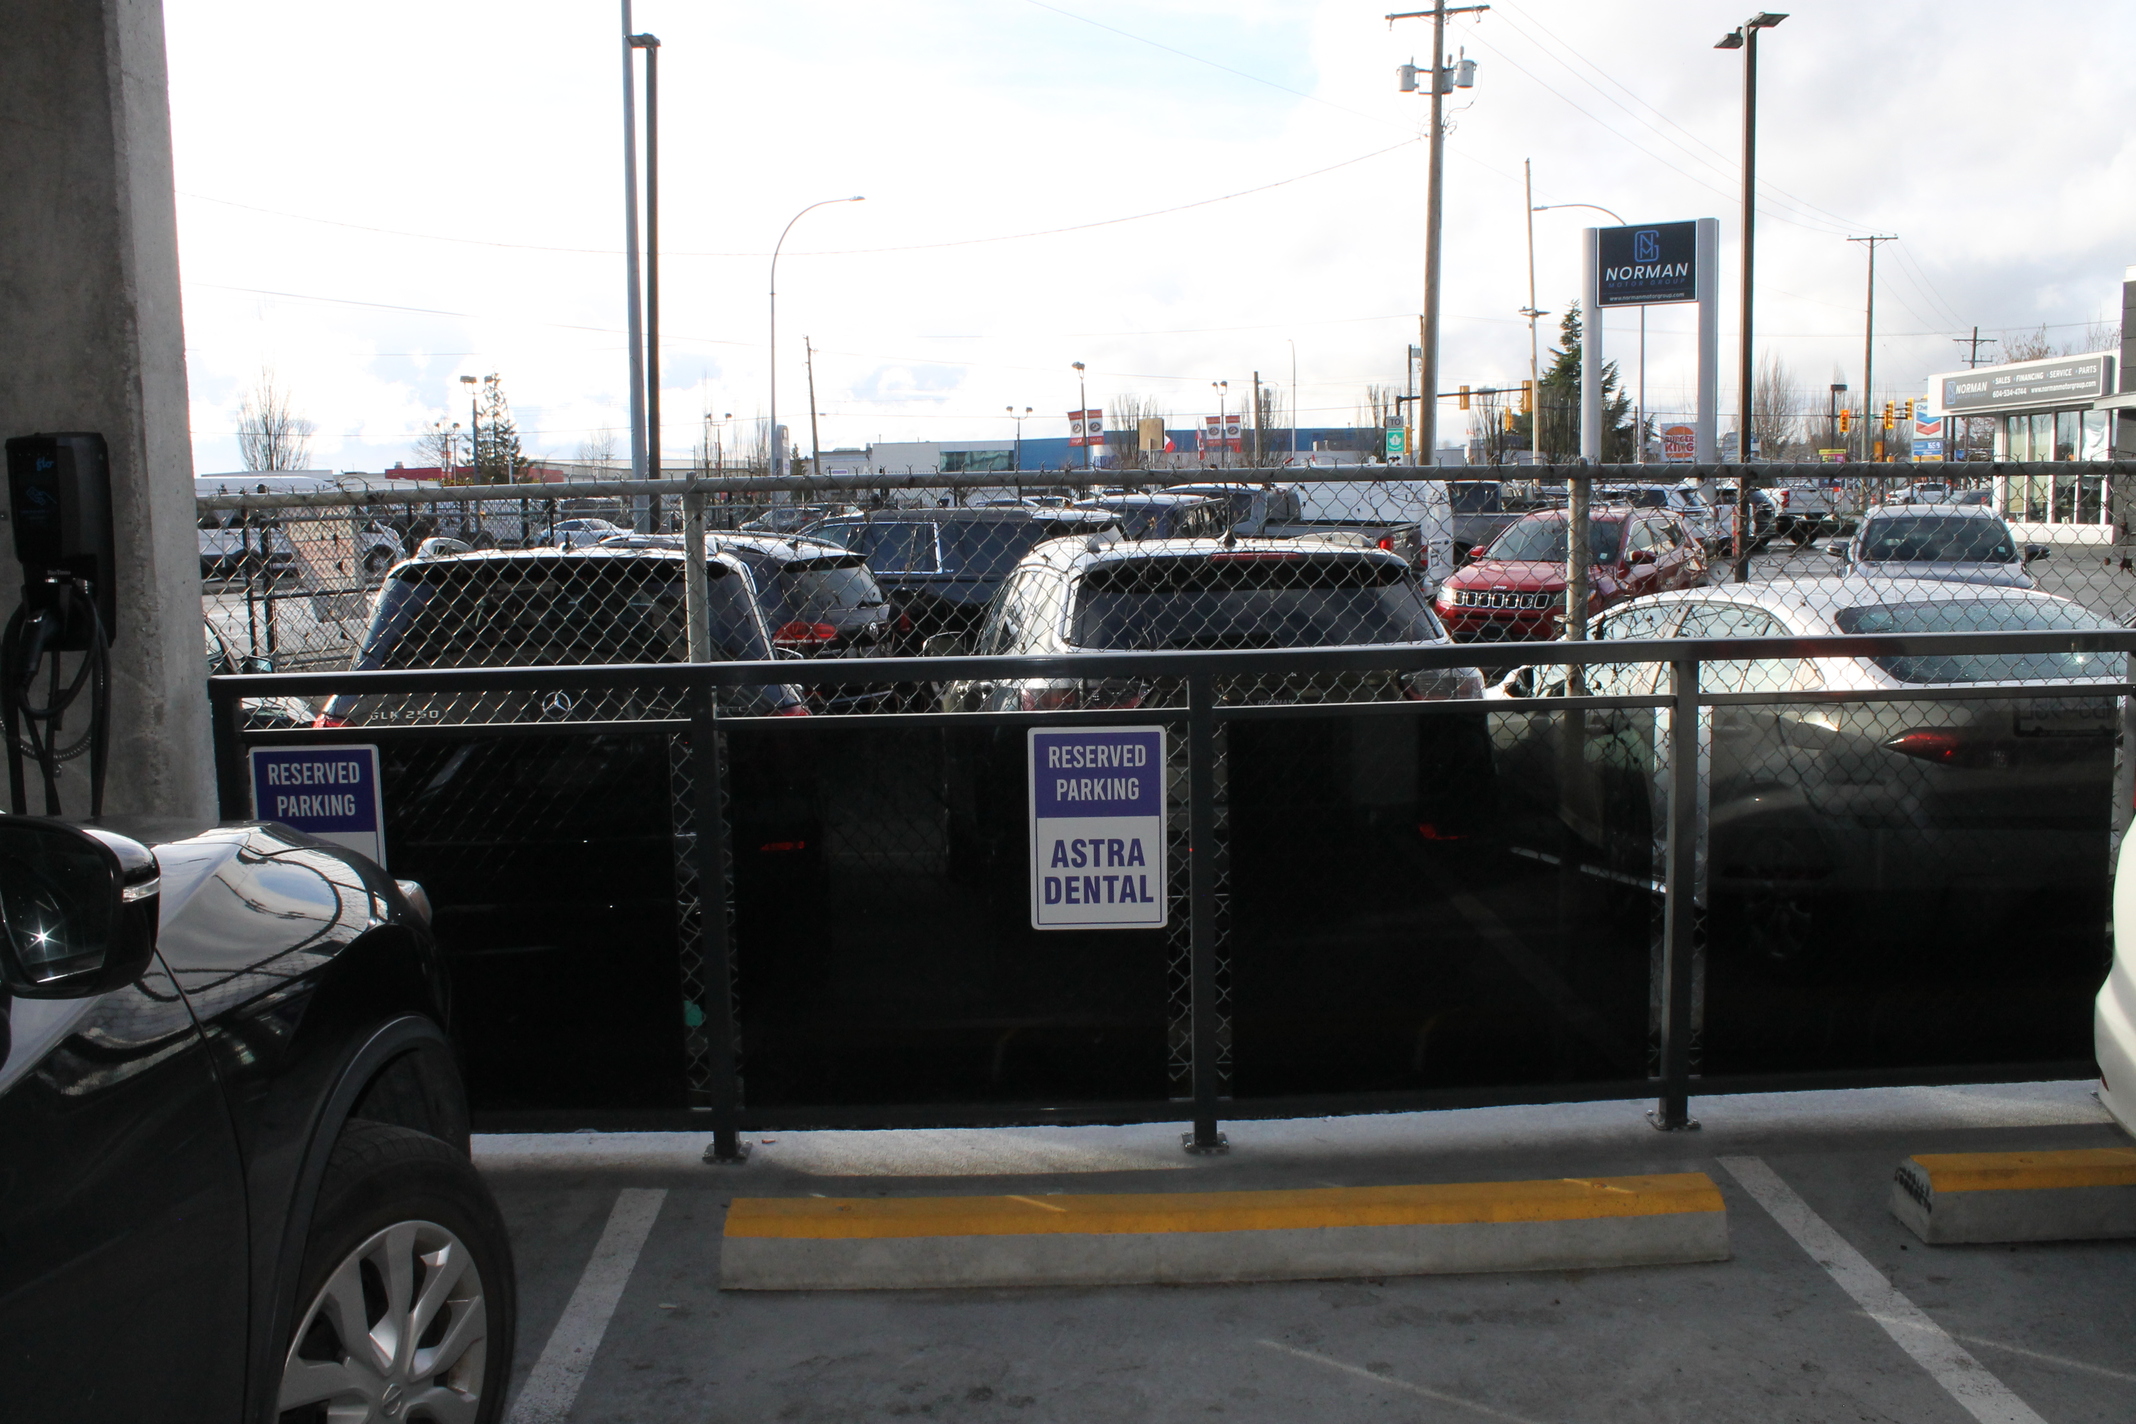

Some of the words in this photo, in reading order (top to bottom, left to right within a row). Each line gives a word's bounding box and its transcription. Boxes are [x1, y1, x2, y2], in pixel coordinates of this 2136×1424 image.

[1605, 262, 1688, 281] NORMAN
[1608, 279, 1643, 288] MOTOR
[1650, 278, 1686, 286] GROUP
[1995, 376, 2011, 385] SALES
[2016, 372, 2044, 382] FINANCING
[2049, 368, 2072, 379] SERVICE
[2078, 365, 2097, 374] PARTS
[1955, 381, 1987, 394] NORMAN
[1390, 418, 1401, 426] TO
[1665, 435, 1694, 443] BURGER
[1665, 442, 1694, 453] KING
[370, 711, 399, 721] GLK
[405, 709, 440, 720] 250
[1048, 744, 1147, 769] RESERVED
[267, 761, 360, 786] RESERVED
[1056, 777, 1140, 802] PARKING
[277, 794, 356, 817] PARKING
[1050, 838, 1146, 869] ASTRA
[1044, 874, 1154, 906] DENTAL
